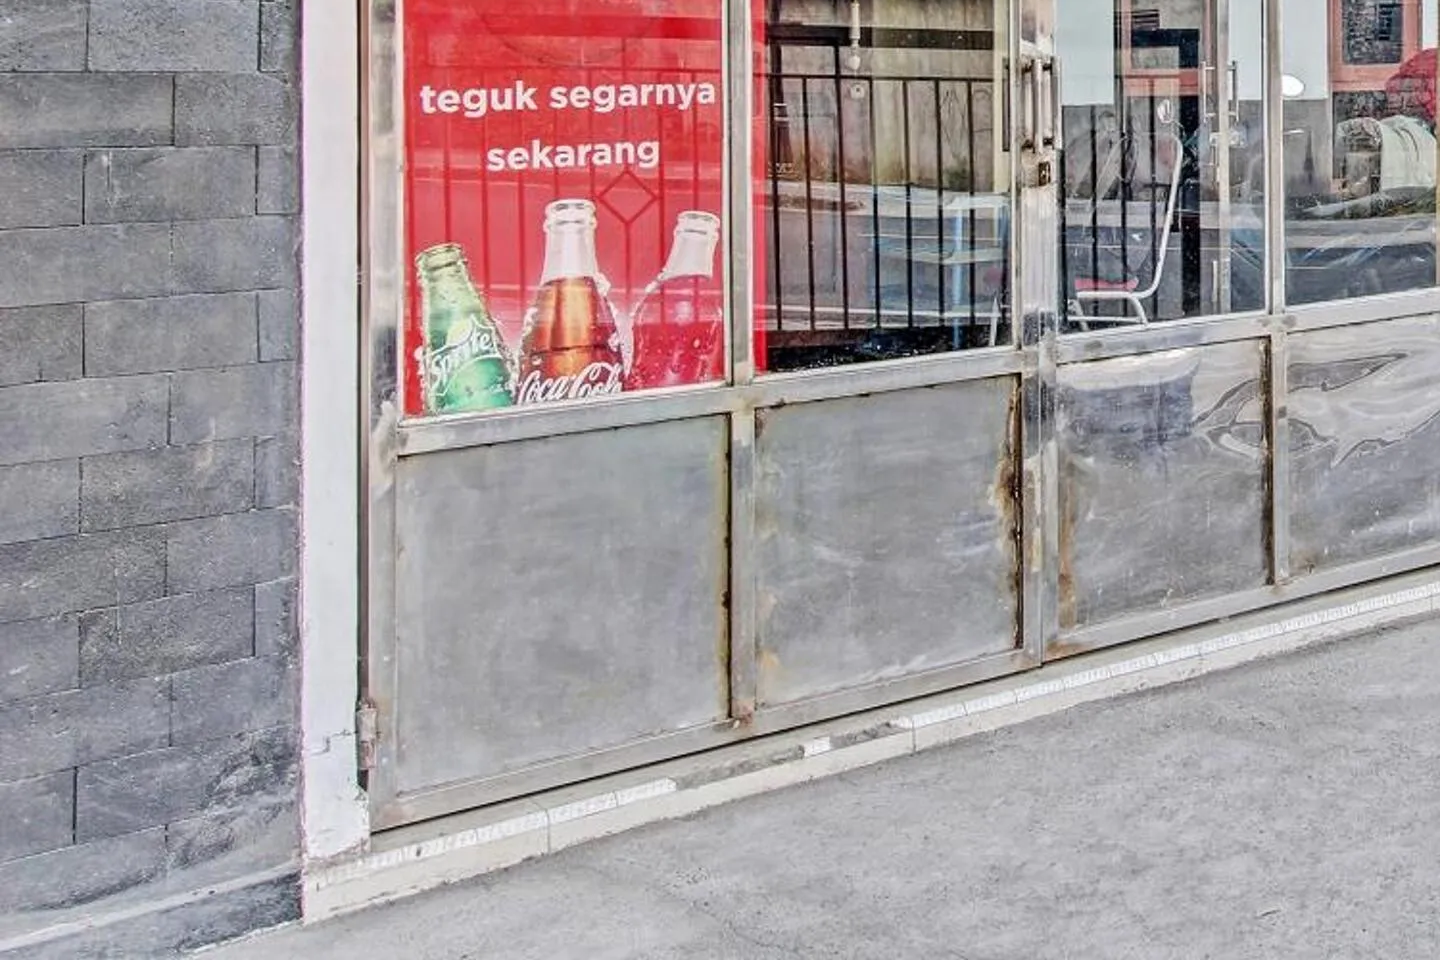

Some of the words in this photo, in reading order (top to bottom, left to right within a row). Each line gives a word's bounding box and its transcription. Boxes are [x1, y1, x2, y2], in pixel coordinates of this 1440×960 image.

[420, 80, 538, 118] teguk
[550, 81, 716, 114] segarnya
[487, 139, 660, 172] sekarang
